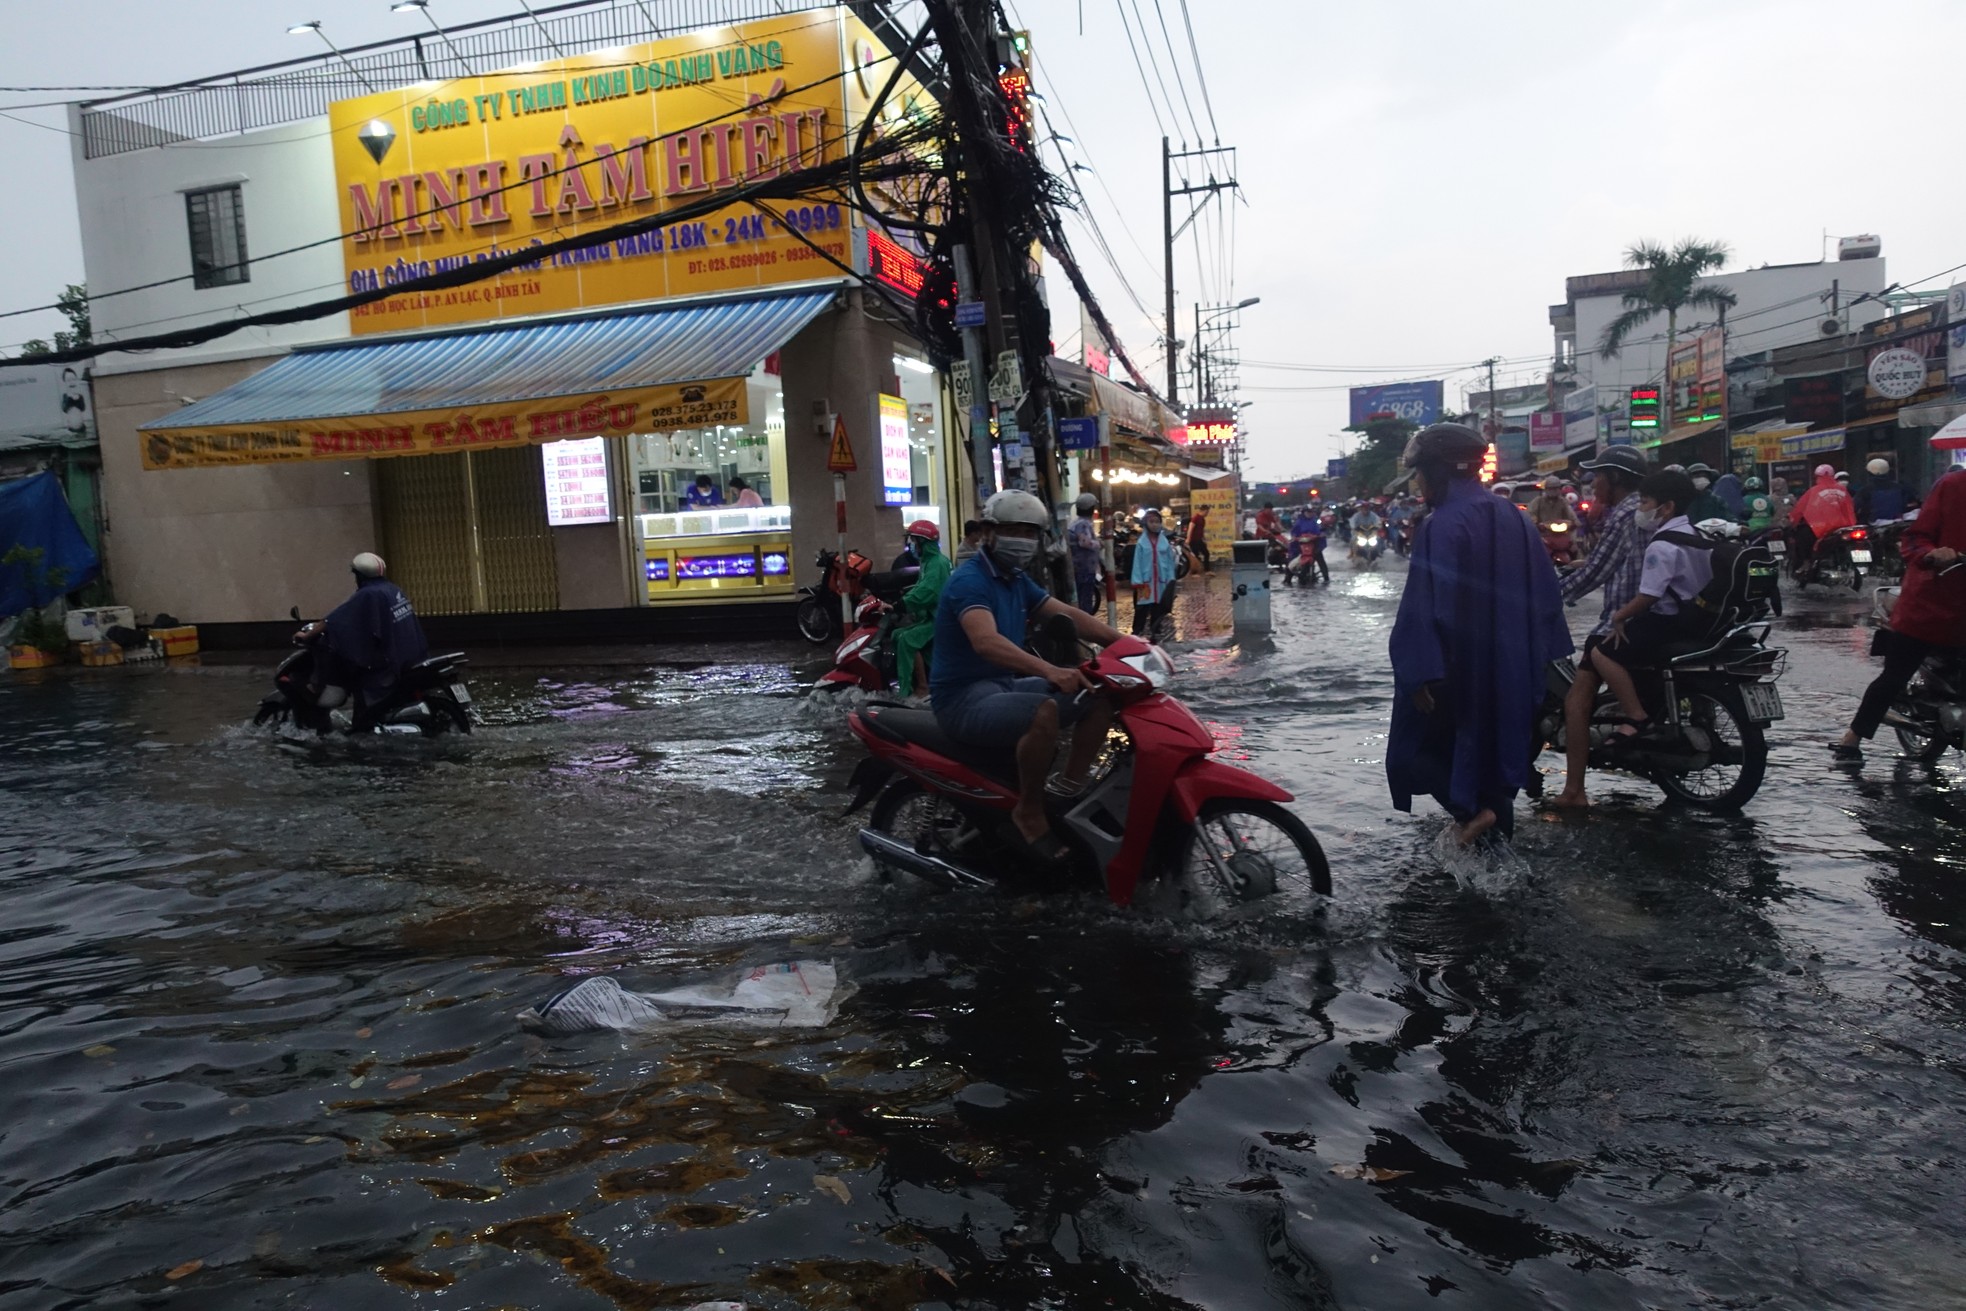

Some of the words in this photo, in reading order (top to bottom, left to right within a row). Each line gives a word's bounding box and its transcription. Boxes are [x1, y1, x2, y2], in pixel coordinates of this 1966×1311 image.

[411, 97, 468, 132] CÔNG
[474, 92, 503, 121] TY
[508, 81, 567, 116] TNHH
[572, 74, 628, 106] KINH
[632, 53, 713, 94] DOANH
[718, 39, 784, 80] VÀNG
[348, 160, 510, 242] MINH
[519, 125, 653, 218] TÂM
[662, 79, 827, 197] HIẾU
[350, 267, 381, 294] GIA
[669, 222, 707, 249] 18K
[724, 213, 767, 244] 24K
[785, 202, 841, 234] 9999
[445, 292, 458, 306] AN
[494, 282, 519, 299] BÌNH
[311, 425, 415, 455] MINH
[424, 412, 518, 448] TÂM
[527, 394, 640, 438] HIẾU
[653, 411, 737, 428] 0938.481.978
